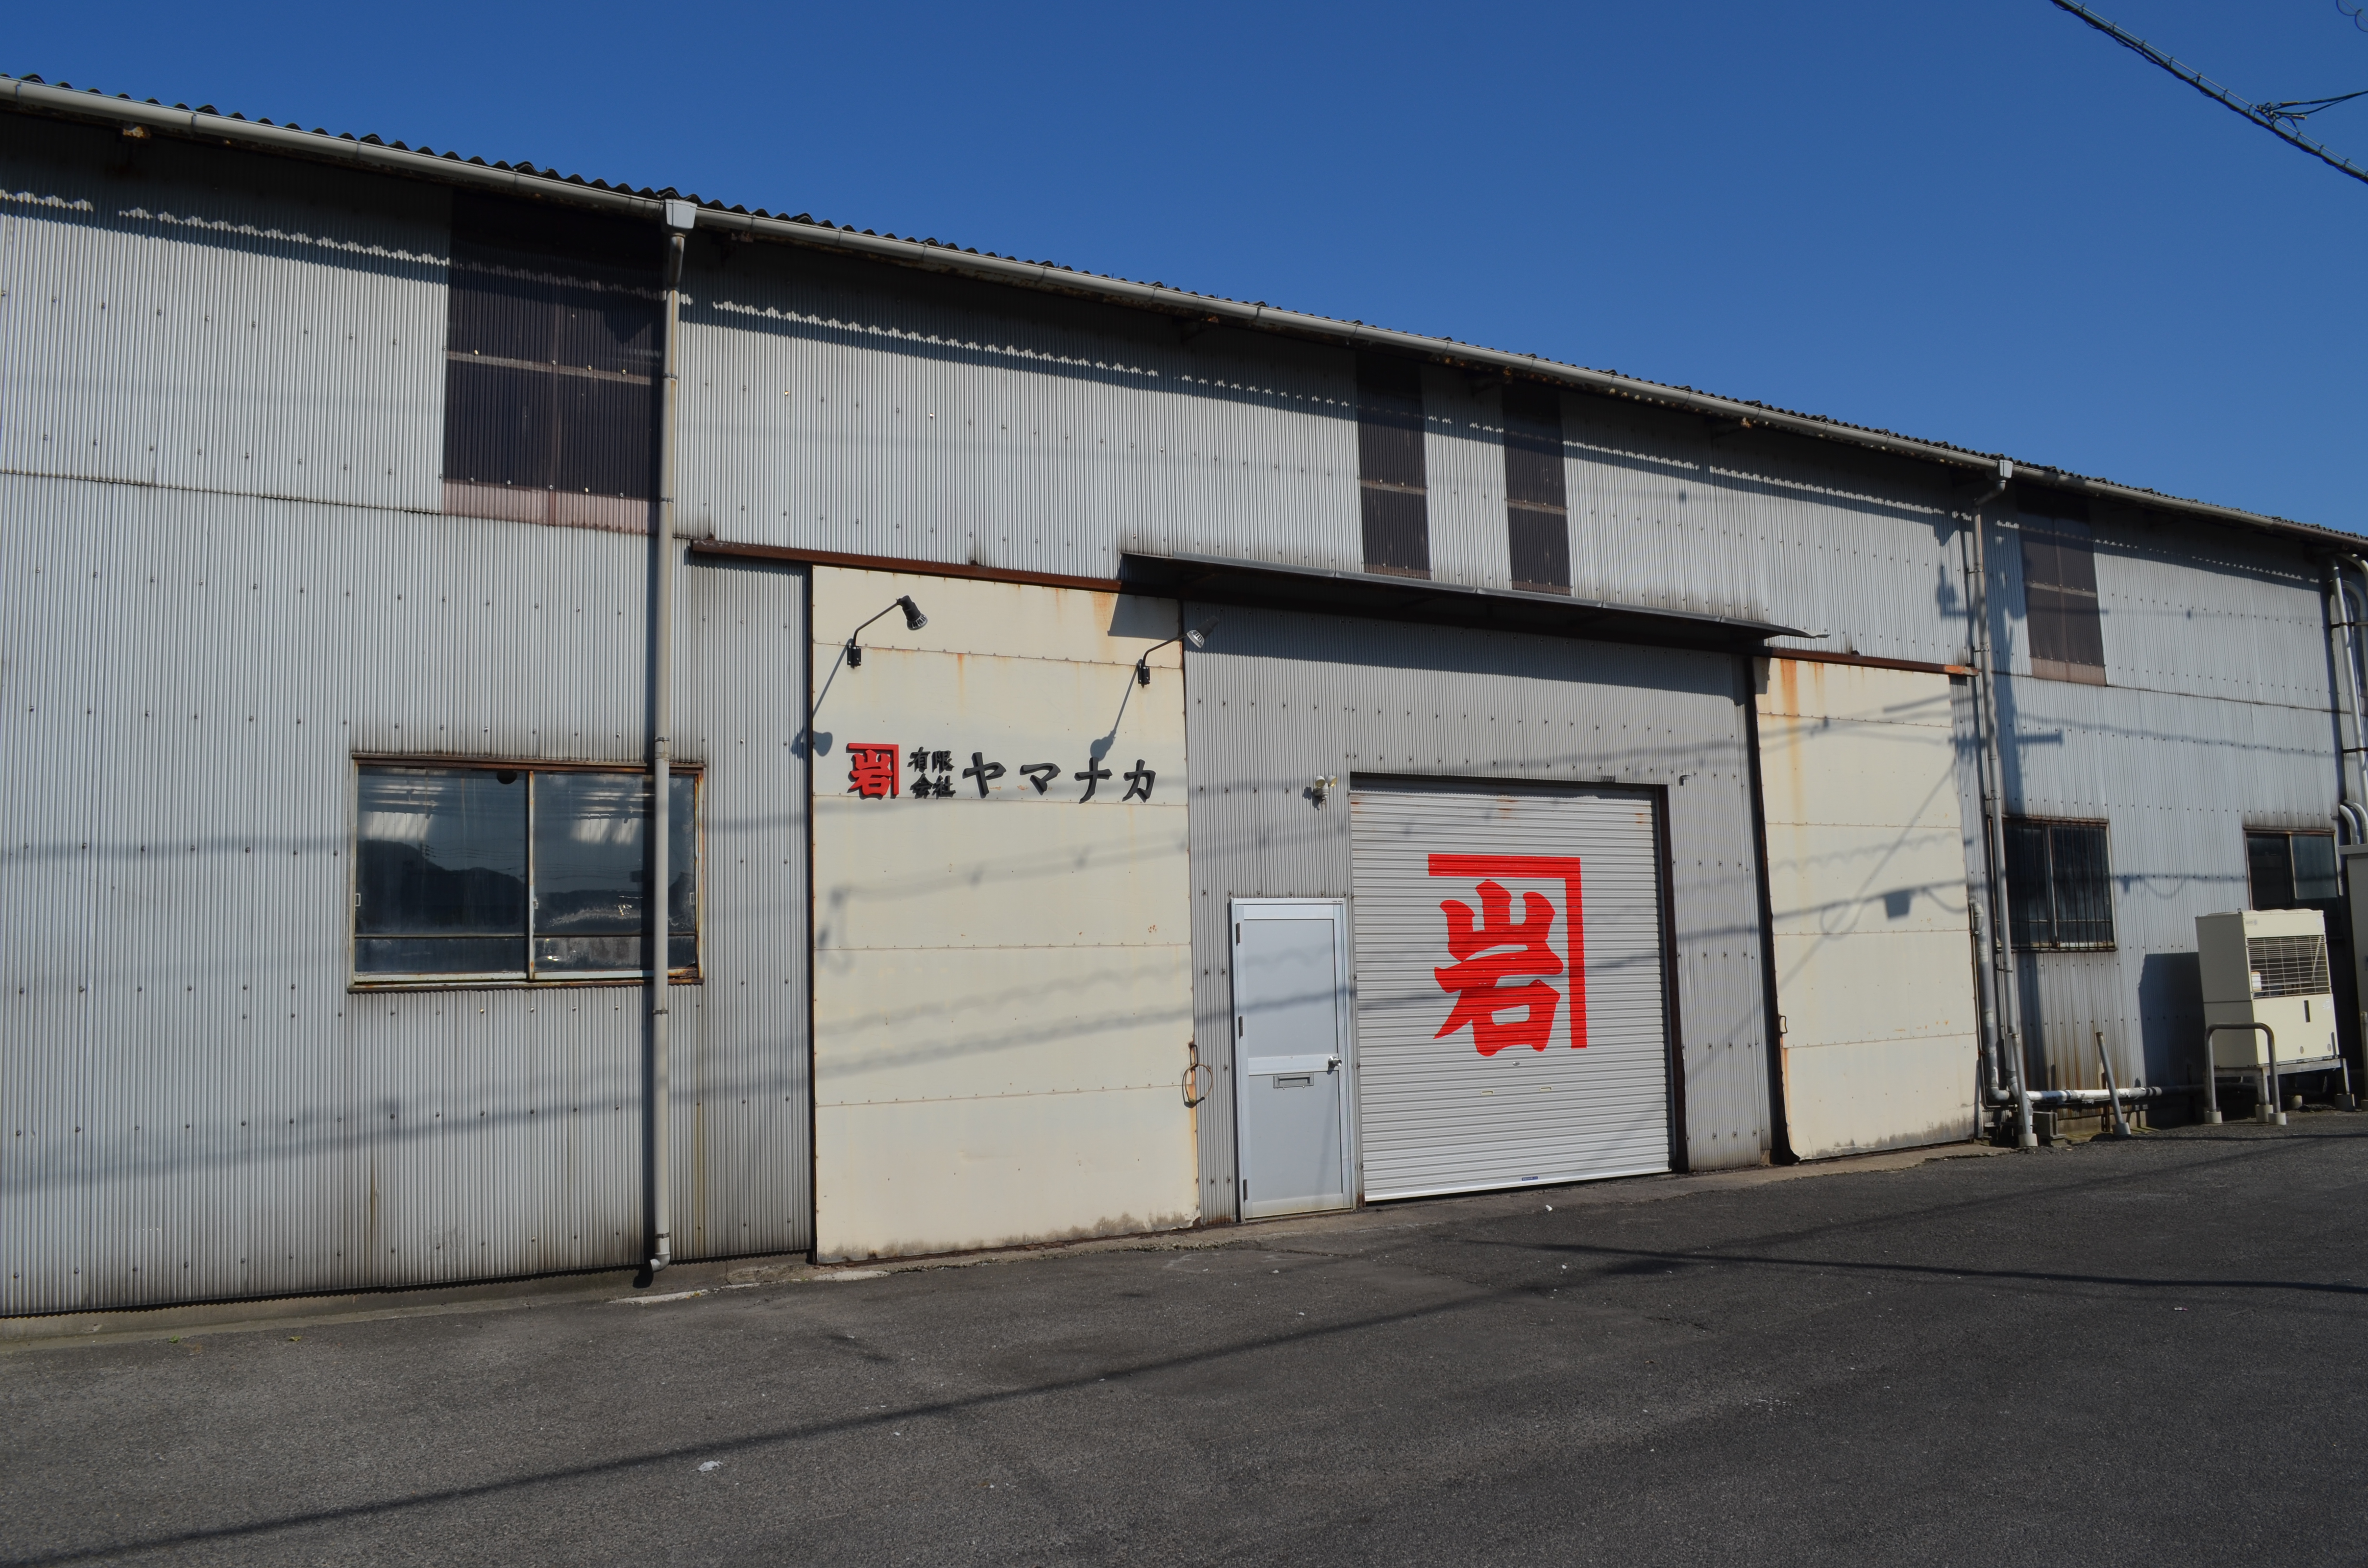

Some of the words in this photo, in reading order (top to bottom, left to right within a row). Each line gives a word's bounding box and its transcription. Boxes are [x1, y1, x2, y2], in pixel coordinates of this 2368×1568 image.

[849, 750, 893, 799] 岩
[907, 746, 955, 773] 有限
[962, 752, 1156, 804] ヤマナカ
[910, 773, 956, 799] 会社
[1433, 879, 1564, 1056] 岩
